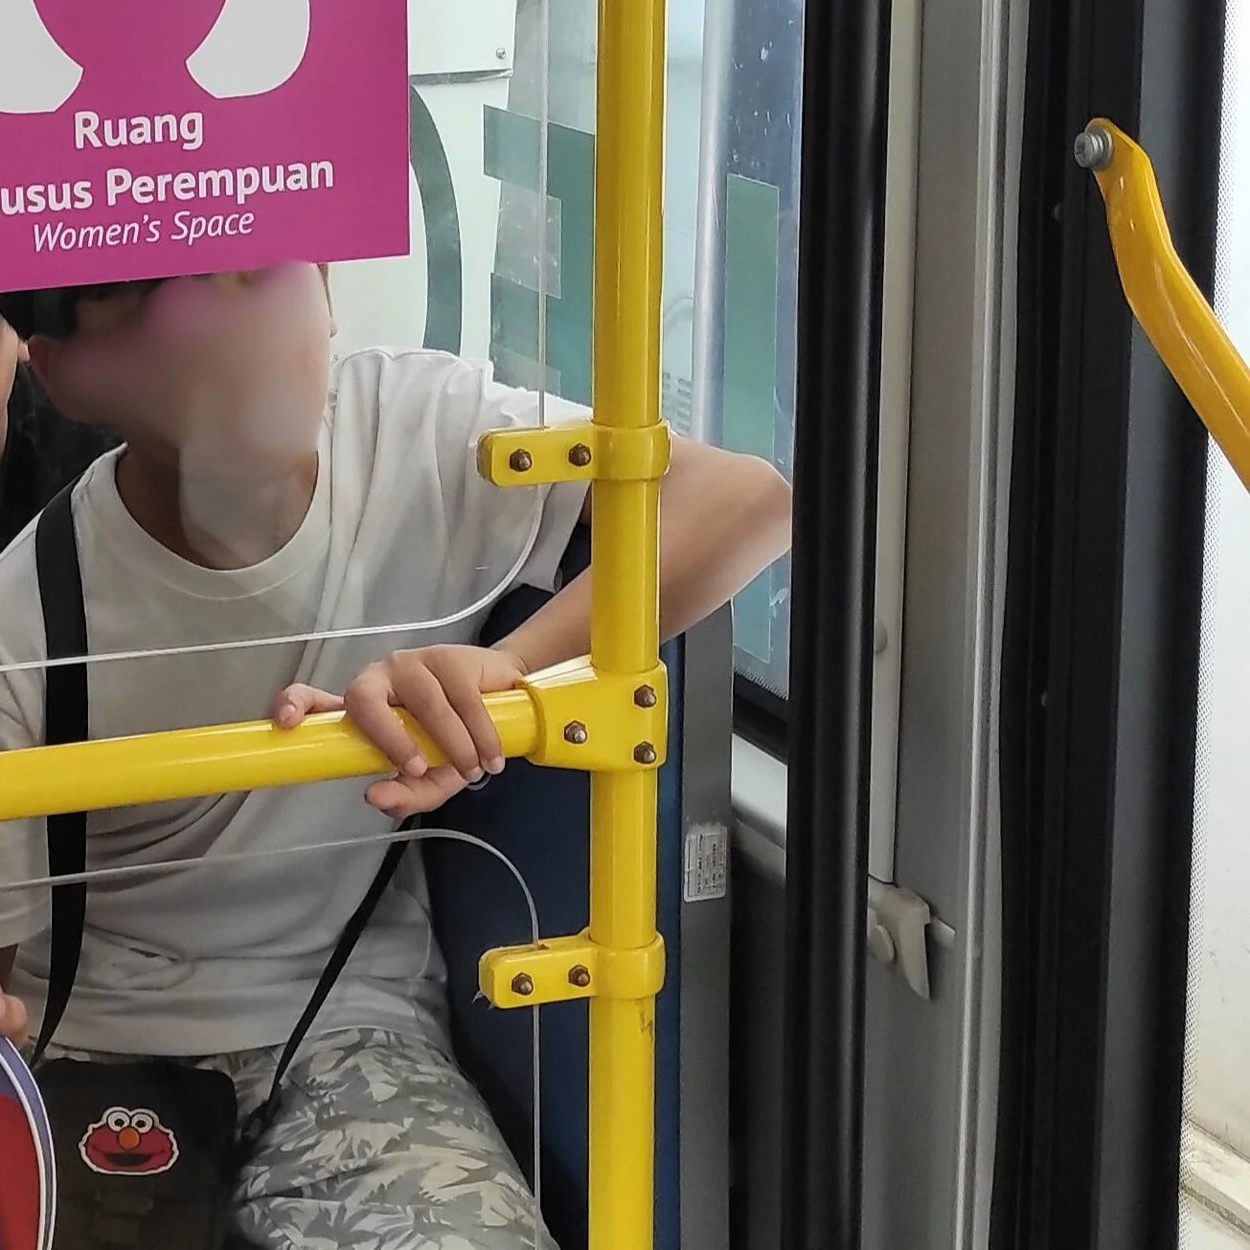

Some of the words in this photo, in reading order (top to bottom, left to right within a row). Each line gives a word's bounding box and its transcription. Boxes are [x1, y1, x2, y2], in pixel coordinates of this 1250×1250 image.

[73, 110, 204, 151] Ruang
[106, 160, 335, 206] Perempuan
[33, 214, 162, 252] Women's
[170, 210, 255, 246] Space
